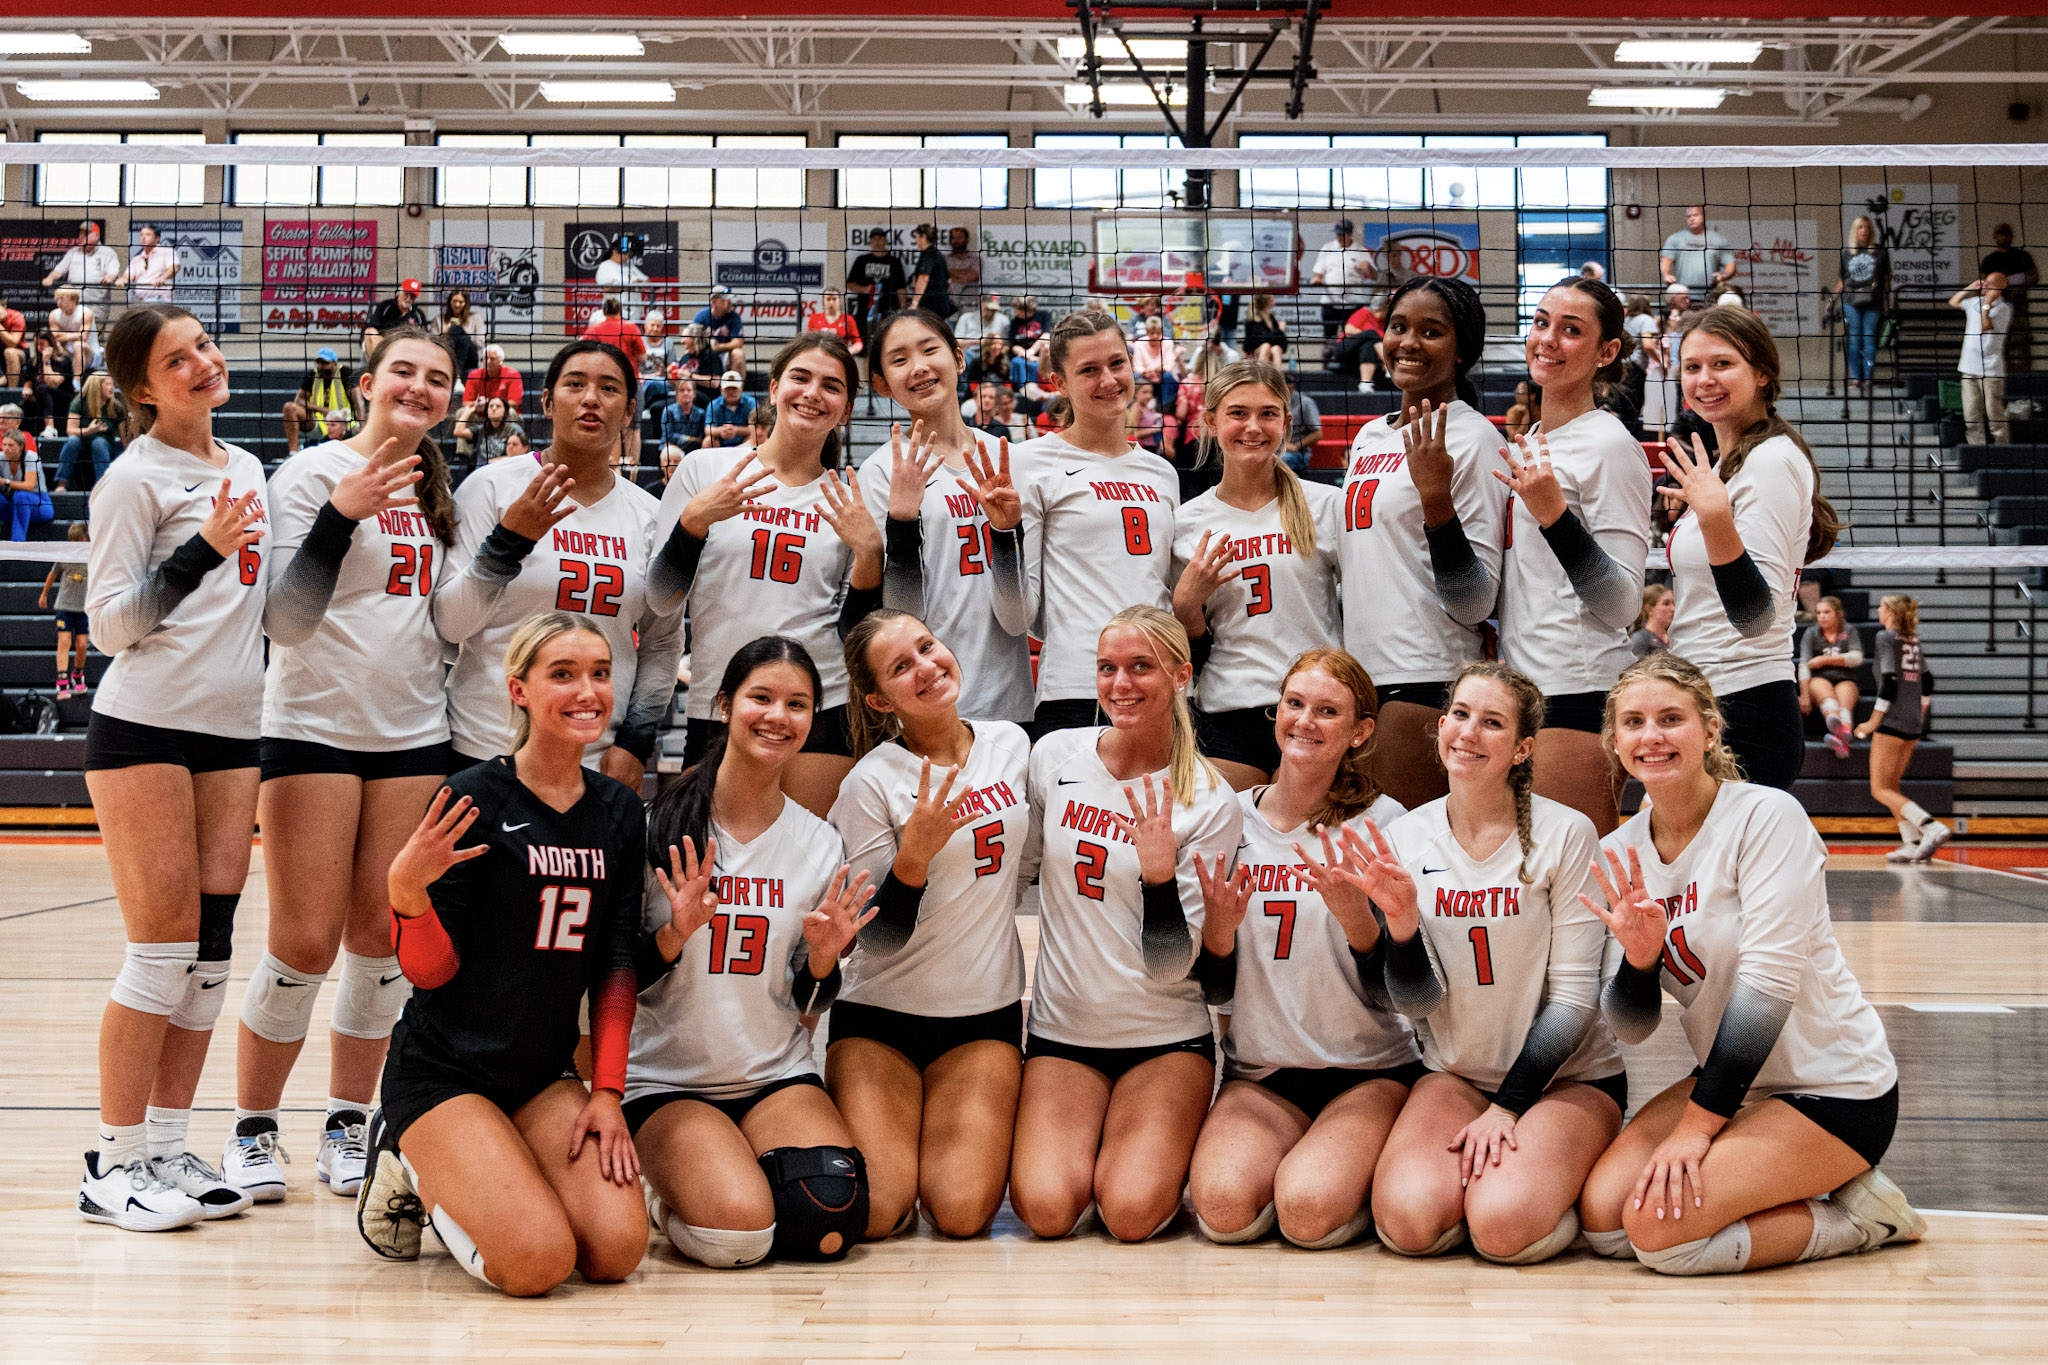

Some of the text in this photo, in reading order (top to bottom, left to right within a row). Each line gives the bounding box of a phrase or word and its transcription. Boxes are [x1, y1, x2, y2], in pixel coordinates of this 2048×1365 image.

[266, 246, 373, 261] SEPTIC PUMPING
[437, 247, 489, 266] BISCUIT
[758, 249, 783, 264] CB
[987, 240, 1087, 258] BACKYARD
[999, 260, 1073, 271] TO NATURE
[183, 267, 238, 278] MULLIS
[268, 263, 370, 278] & INSTALLATION
[436, 270, 498, 287] EXPRESS
[750, 300, 818, 318] RAIDERS
[1350, 452, 1408, 477] NORTH
[1089, 482, 1161, 503] NORTH
[1345, 479, 1380, 532] 18
[744, 499, 820, 533] NORTH
[1121, 507, 1153, 555] 8
[238, 530, 261, 586] 6
[553, 528, 627, 560] NORTH
[750, 528, 806, 584] 16
[1216, 533, 1293, 563] NORTH
[385, 542, 433, 597] 21
[555, 558, 624, 617] 22
[1241, 563, 1273, 617] 3
[527, 844, 606, 880] NORTH
[972, 819, 1005, 879] 5
[1074, 839, 1109, 902] 2
[534, 885, 592, 952] 12
[1435, 886, 1520, 918] NORTH
[708, 913, 770, 976] 13
[1263, 900, 1297, 960] 7
[1468, 926, 1495, 986] 1
